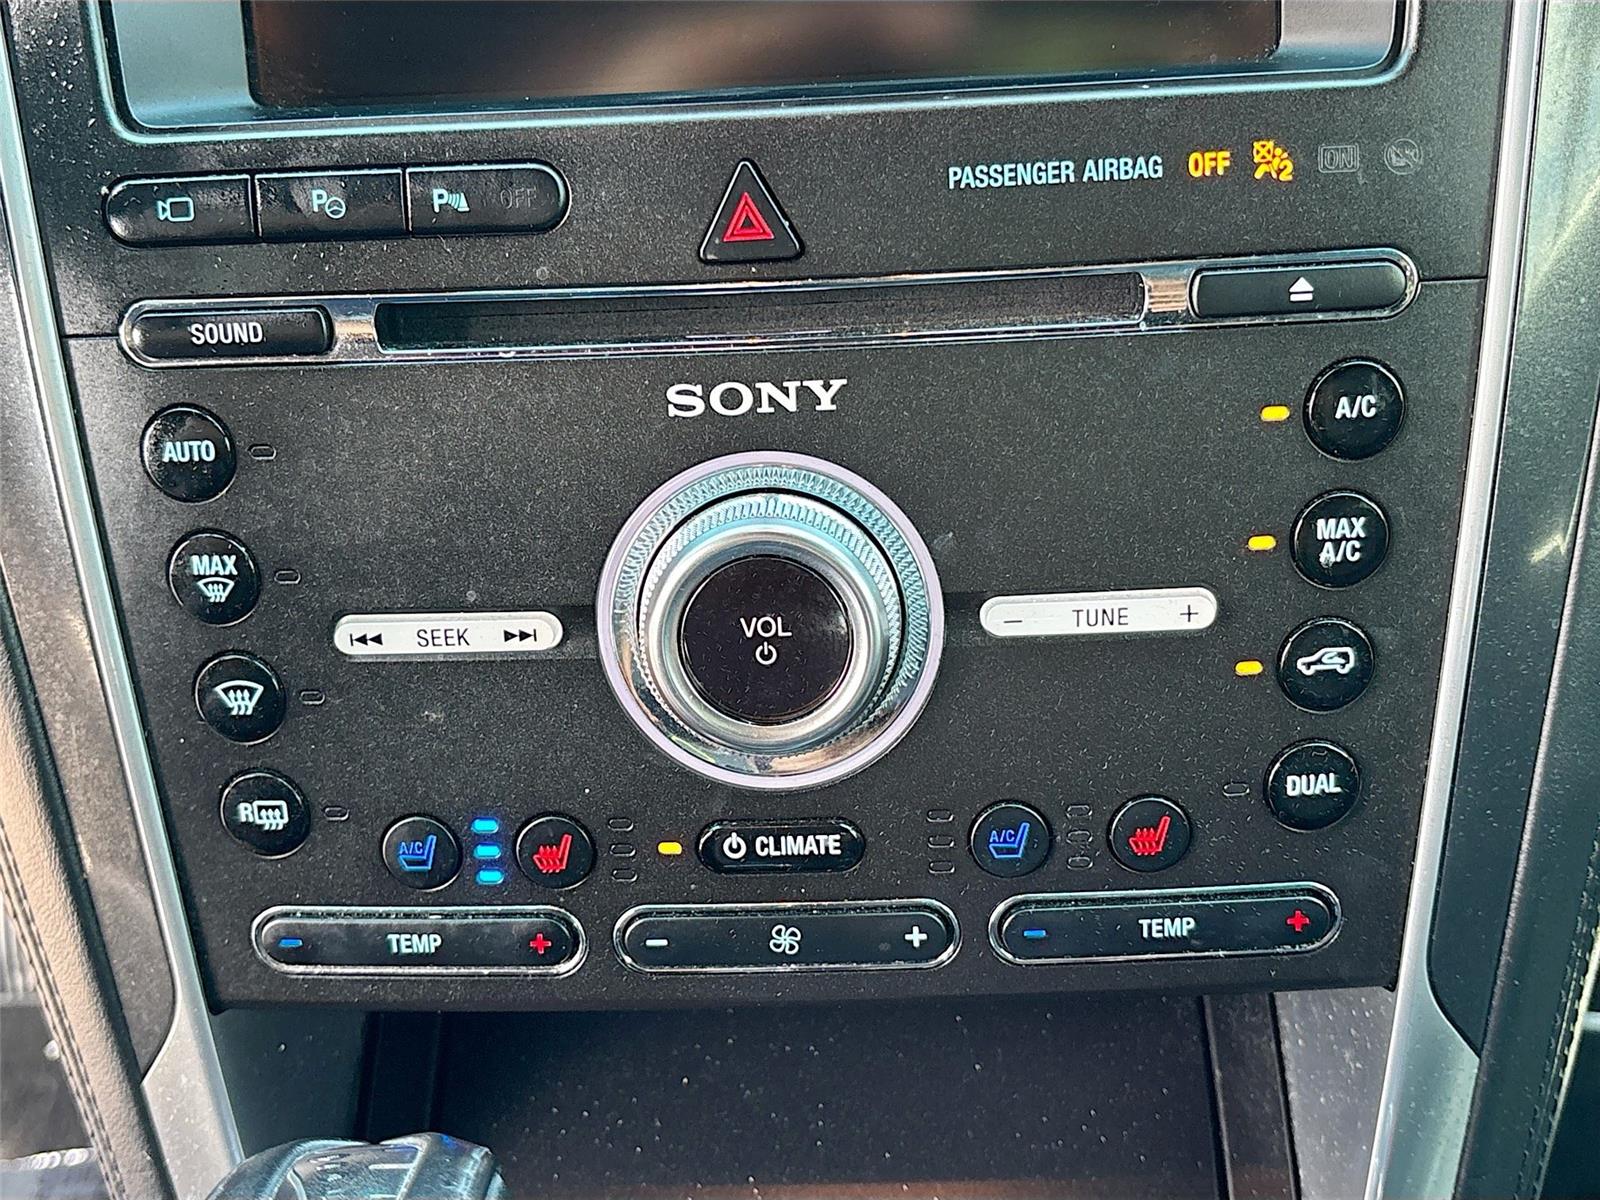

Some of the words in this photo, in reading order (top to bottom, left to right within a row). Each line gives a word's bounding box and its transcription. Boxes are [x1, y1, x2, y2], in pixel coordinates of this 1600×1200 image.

[948, 158, 1075, 189] PASSENGER
[1082, 155, 1163, 183] AIRBAG
[1188, 151, 1231, 178] OFF
[1323, 149, 1354, 168] ON
[500, 187, 538, 210] OFF
[190, 321, 263, 345] SOUND
[666, 379, 848, 418] SONY
[1335, 394, 1377, 419] A/C
[162, 439, 216, 463] AUTO
[1316, 516, 1367, 540] MAX
[1319, 540, 1362, 563] A/C
[191, 554, 239, 577] MAX
[740, 615, 793, 638] VOL
[1071, 608, 1130, 628] TUNE
[416, 628, 471, 648] SEEK
[1285, 771, 1342, 797] DUAL
[755, 833, 842, 858] CLIMATE
[988, 828, 1016, 845] A/C
[399, 840, 424, 857] A/C
[1138, 917, 1196, 940] TEMP
[387, 933, 442, 955] TEMP
